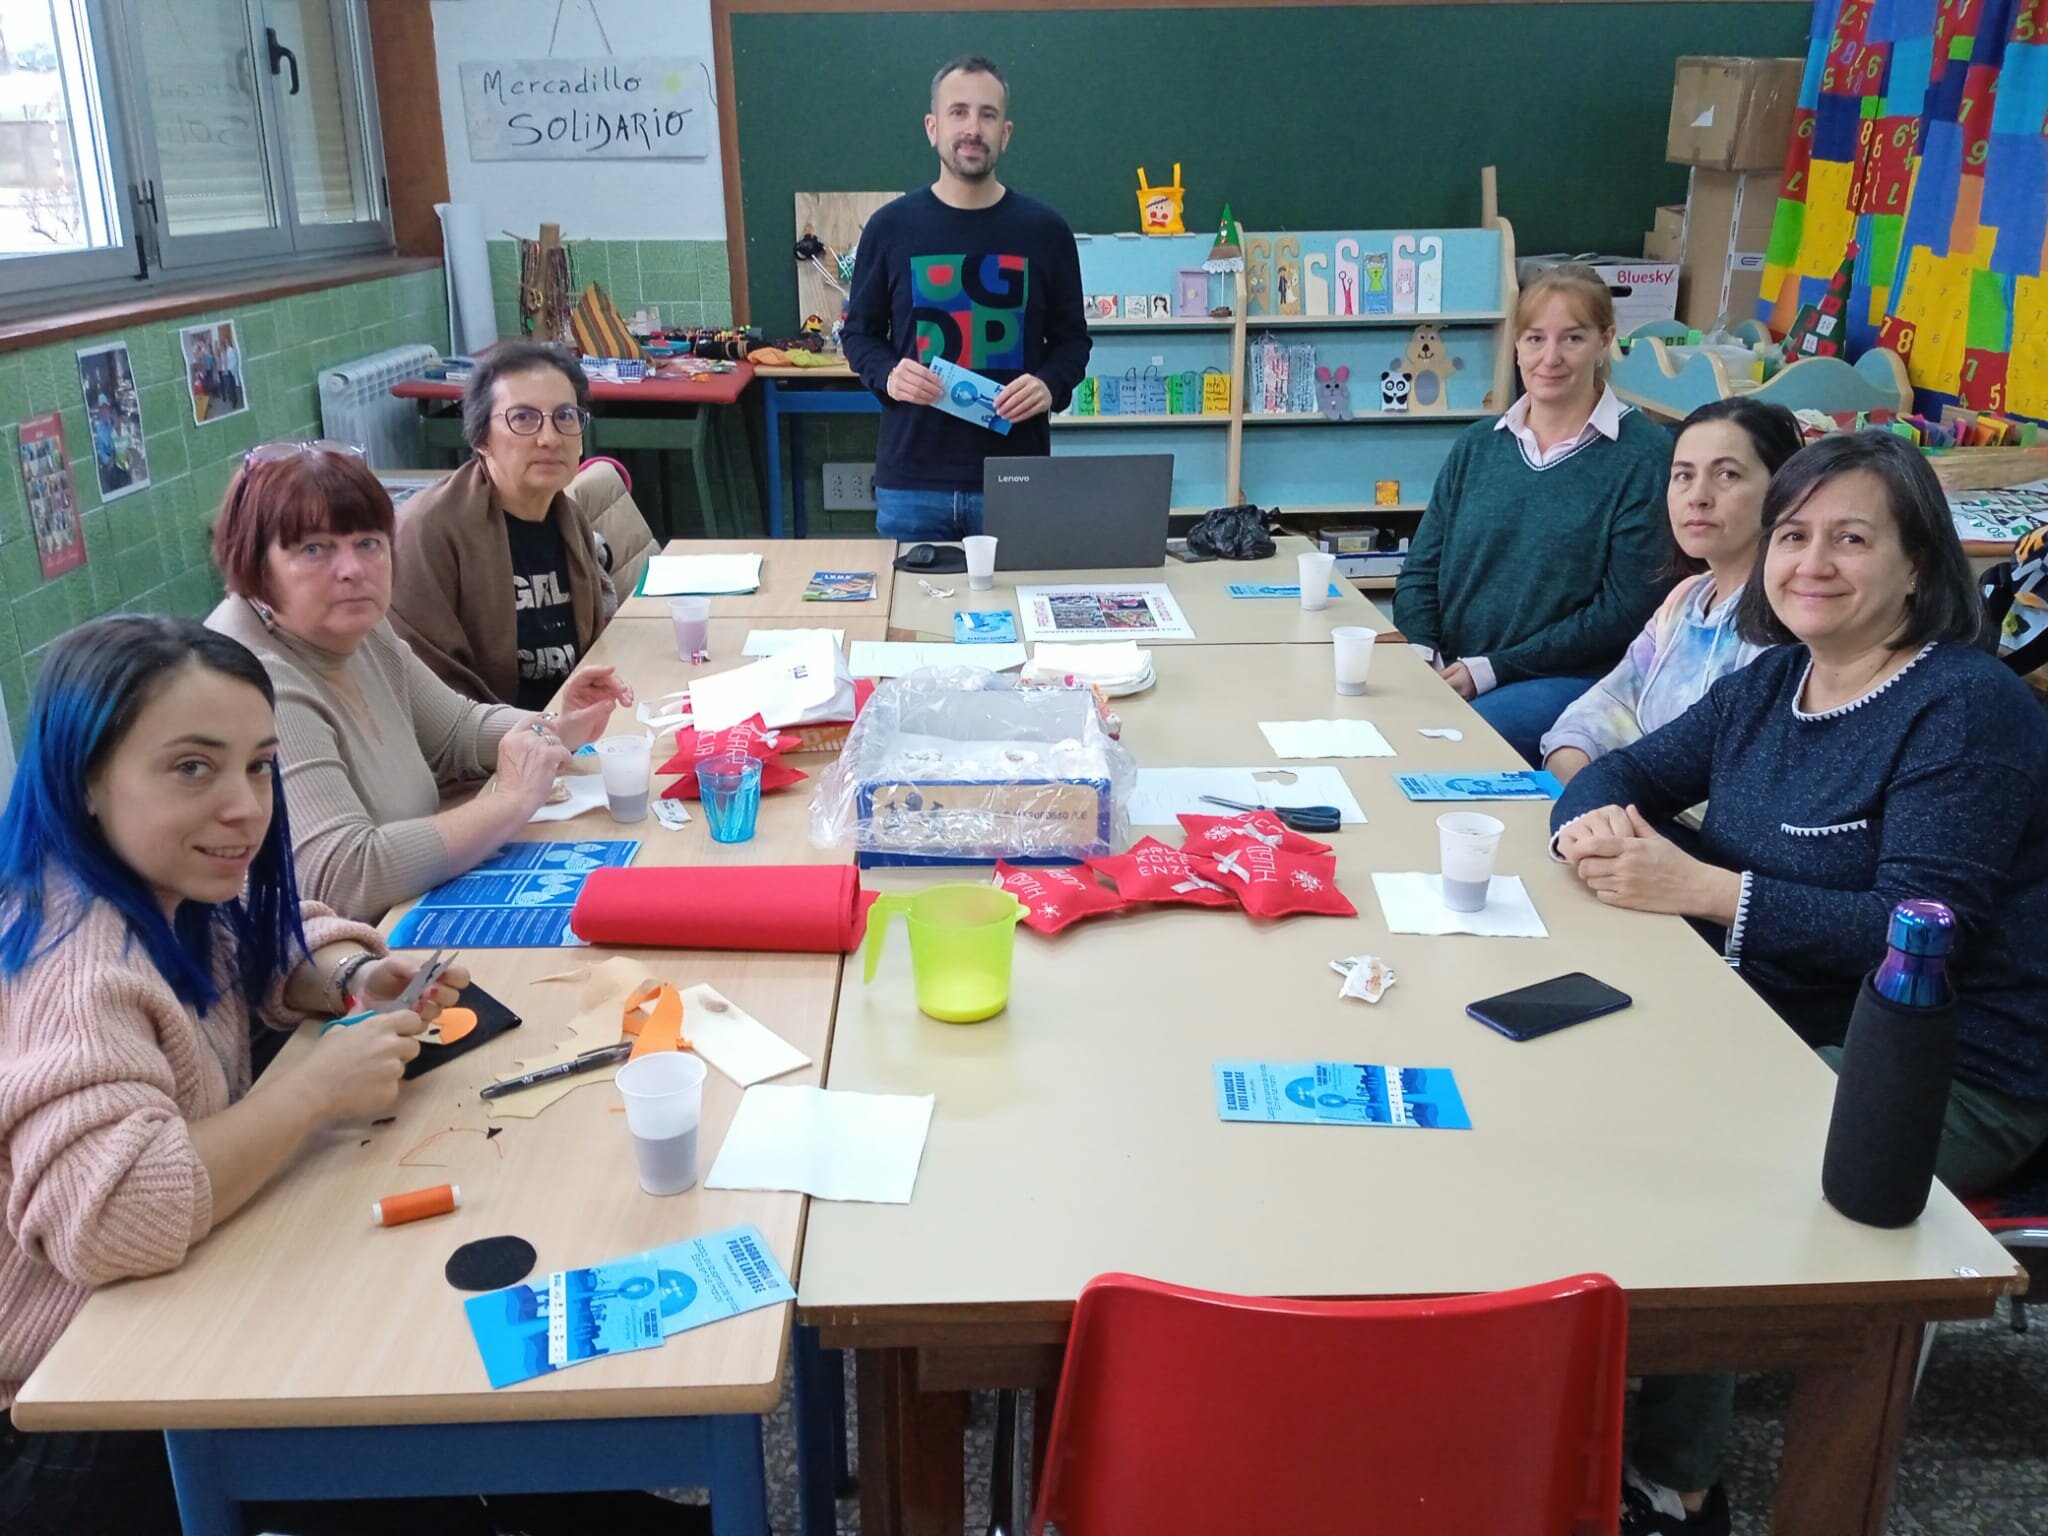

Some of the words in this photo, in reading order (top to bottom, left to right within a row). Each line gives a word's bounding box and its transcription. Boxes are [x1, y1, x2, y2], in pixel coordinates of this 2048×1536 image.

[2015, 10, 2035, 41] 5
[483, 66, 642, 105] Mercadillo
[1860, 120, 1874, 145] 8
[1966, 140, 1989, 165] 9
[1617, 268, 1674, 285] Bluesky
[1879, 316, 1893, 339] 7
[1896, 328, 1914, 354] 8
[1965, 358, 1978, 383] 7
[1988, 383, 2001, 410] 5
[998, 475, 1030, 483] Lenovo
[1246, 845, 1278, 883] HUGO
[739, 1235, 752, 1244] EL
[725, 1239, 748, 1263] PUEDE
[738, 1262, 767, 1294] LAVARSE
